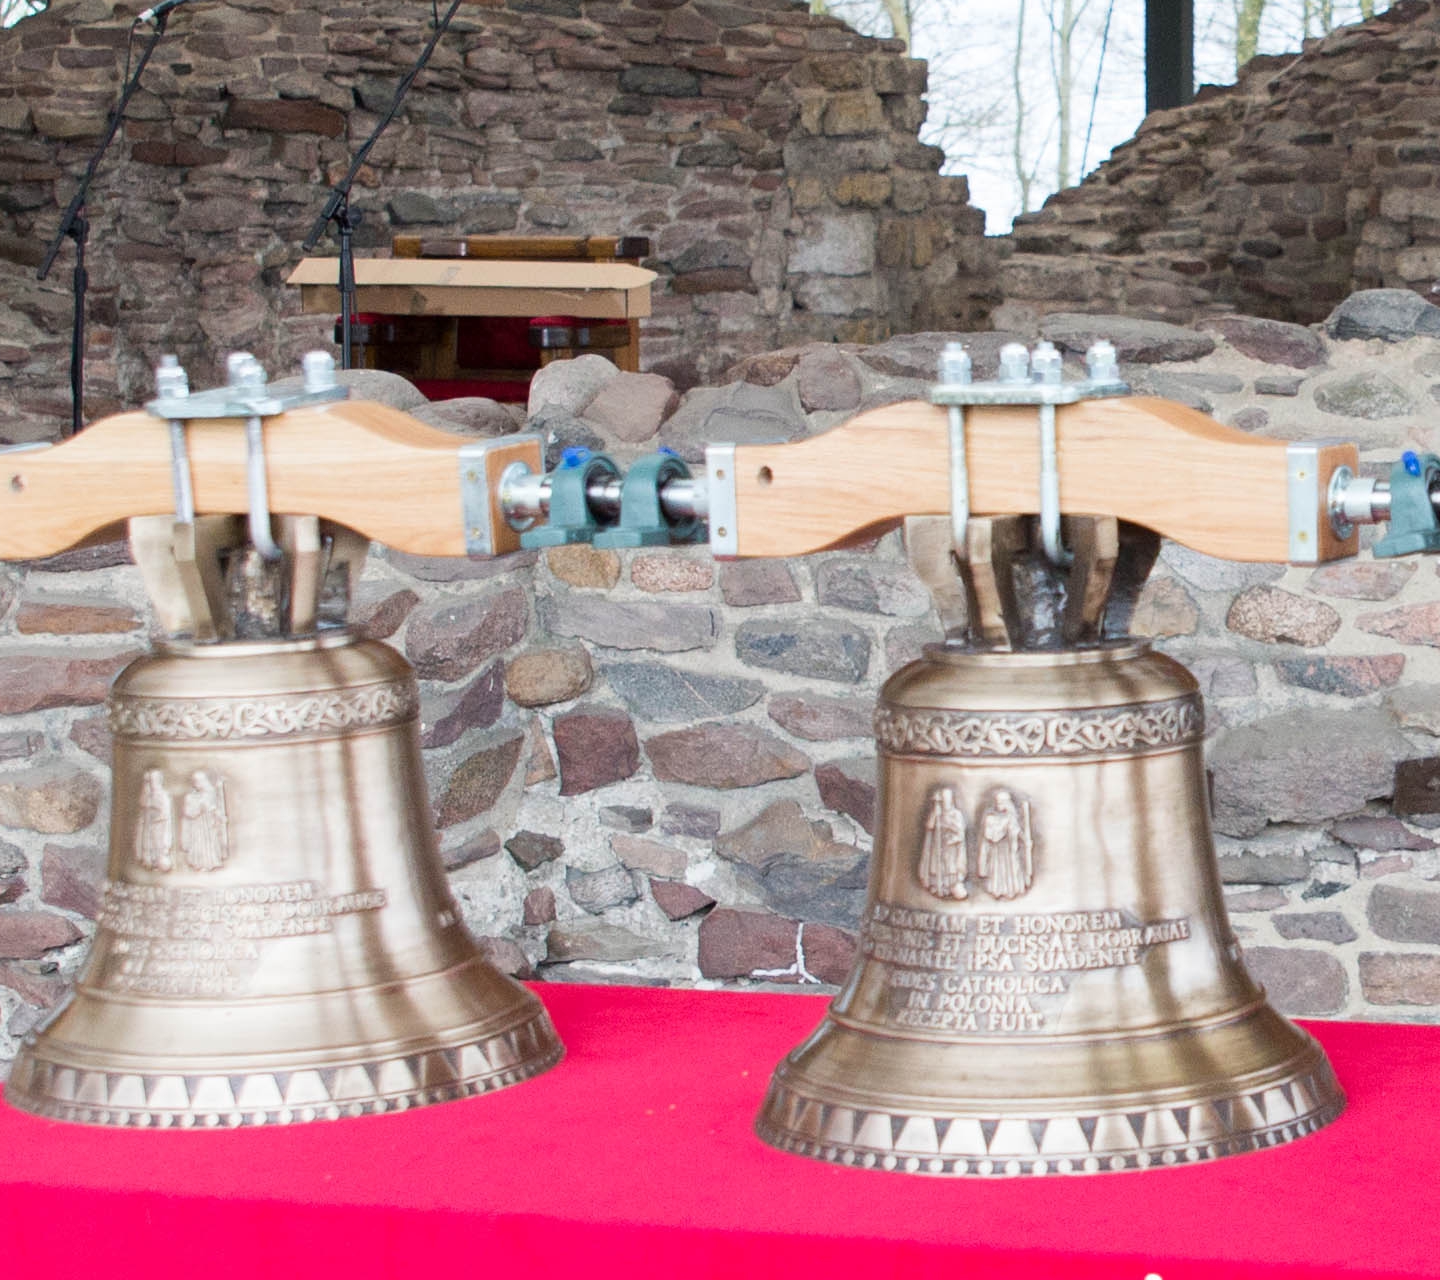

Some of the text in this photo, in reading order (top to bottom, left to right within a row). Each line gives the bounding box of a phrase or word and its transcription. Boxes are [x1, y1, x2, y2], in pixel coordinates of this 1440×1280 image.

[976, 914, 1006, 935] ET
[1015, 910, 1122, 935] HONOREM
[976, 932, 1079, 955] DUCISSAE
[968, 951, 1013, 972] IPSA
[1025, 946, 1141, 972] SUADENTE
[943, 974, 1066, 995] CATHOLICA
[907, 989, 1033, 1014] IN POLONIA
[895, 1007, 1043, 1032] RECEPTA FUIT
